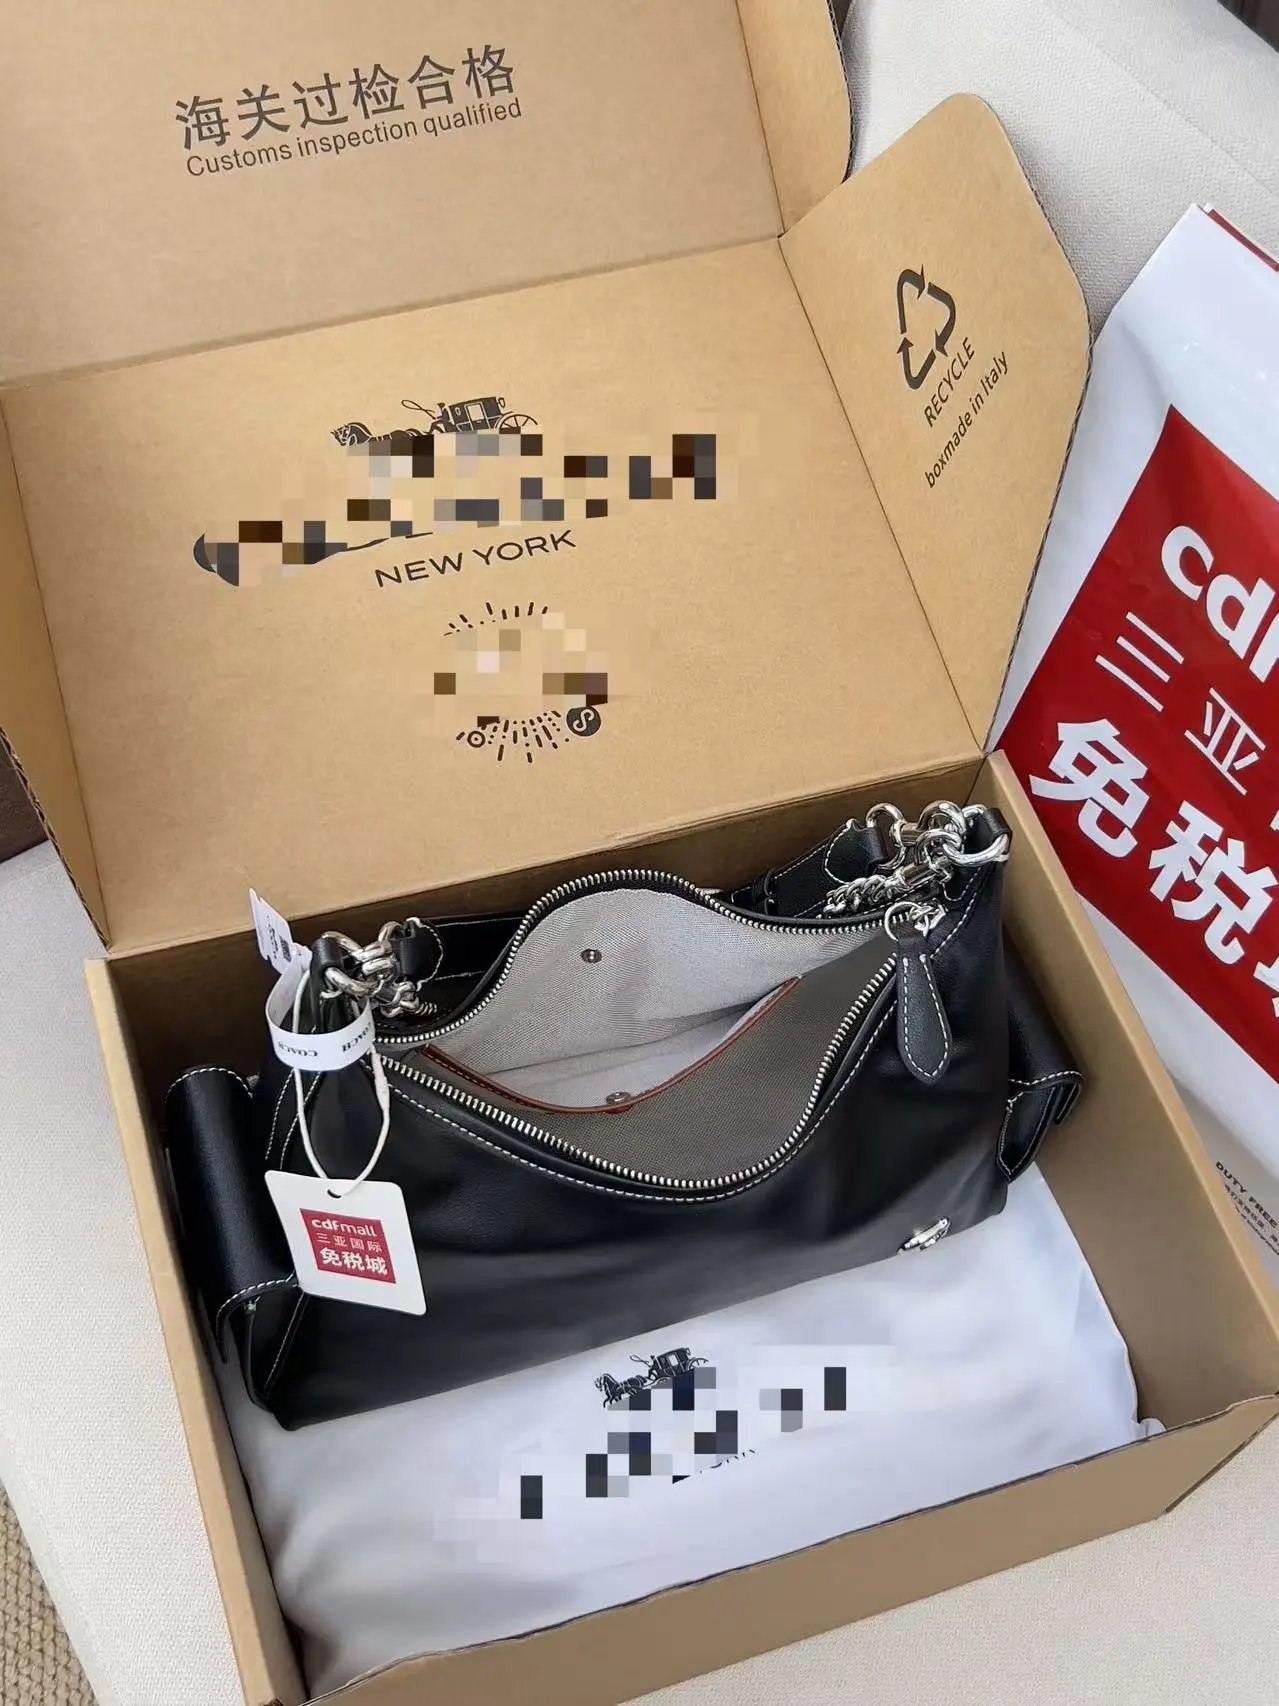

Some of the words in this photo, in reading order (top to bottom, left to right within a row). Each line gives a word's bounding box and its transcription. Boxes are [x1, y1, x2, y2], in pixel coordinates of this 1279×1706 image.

[175, 44, 515, 151] 海关过检合格
[186, 143, 293, 177] Customs
[296, 120, 418, 158] inspection
[423, 96, 522, 137] qualified
[923, 336, 975, 428] RECYCLE
[924, 411, 973, 489] boxmade
[969, 393, 985, 415] in
[980, 351, 1008, 396] Italy
[374, 551, 464, 588] NEW
[471, 529, 577, 566] YORK
[1095, 611, 1279, 830] 三亚
[1029, 718, 1279, 1018] 免税
[311, 1219, 377, 1237] cdfmall
[1216, 1161, 1247, 1194] DUTY
[1248, 1195, 1278, 1229] FREE
[316, 1232, 382, 1252] 三亚国际
[320, 1247, 388, 1276] 免税城
